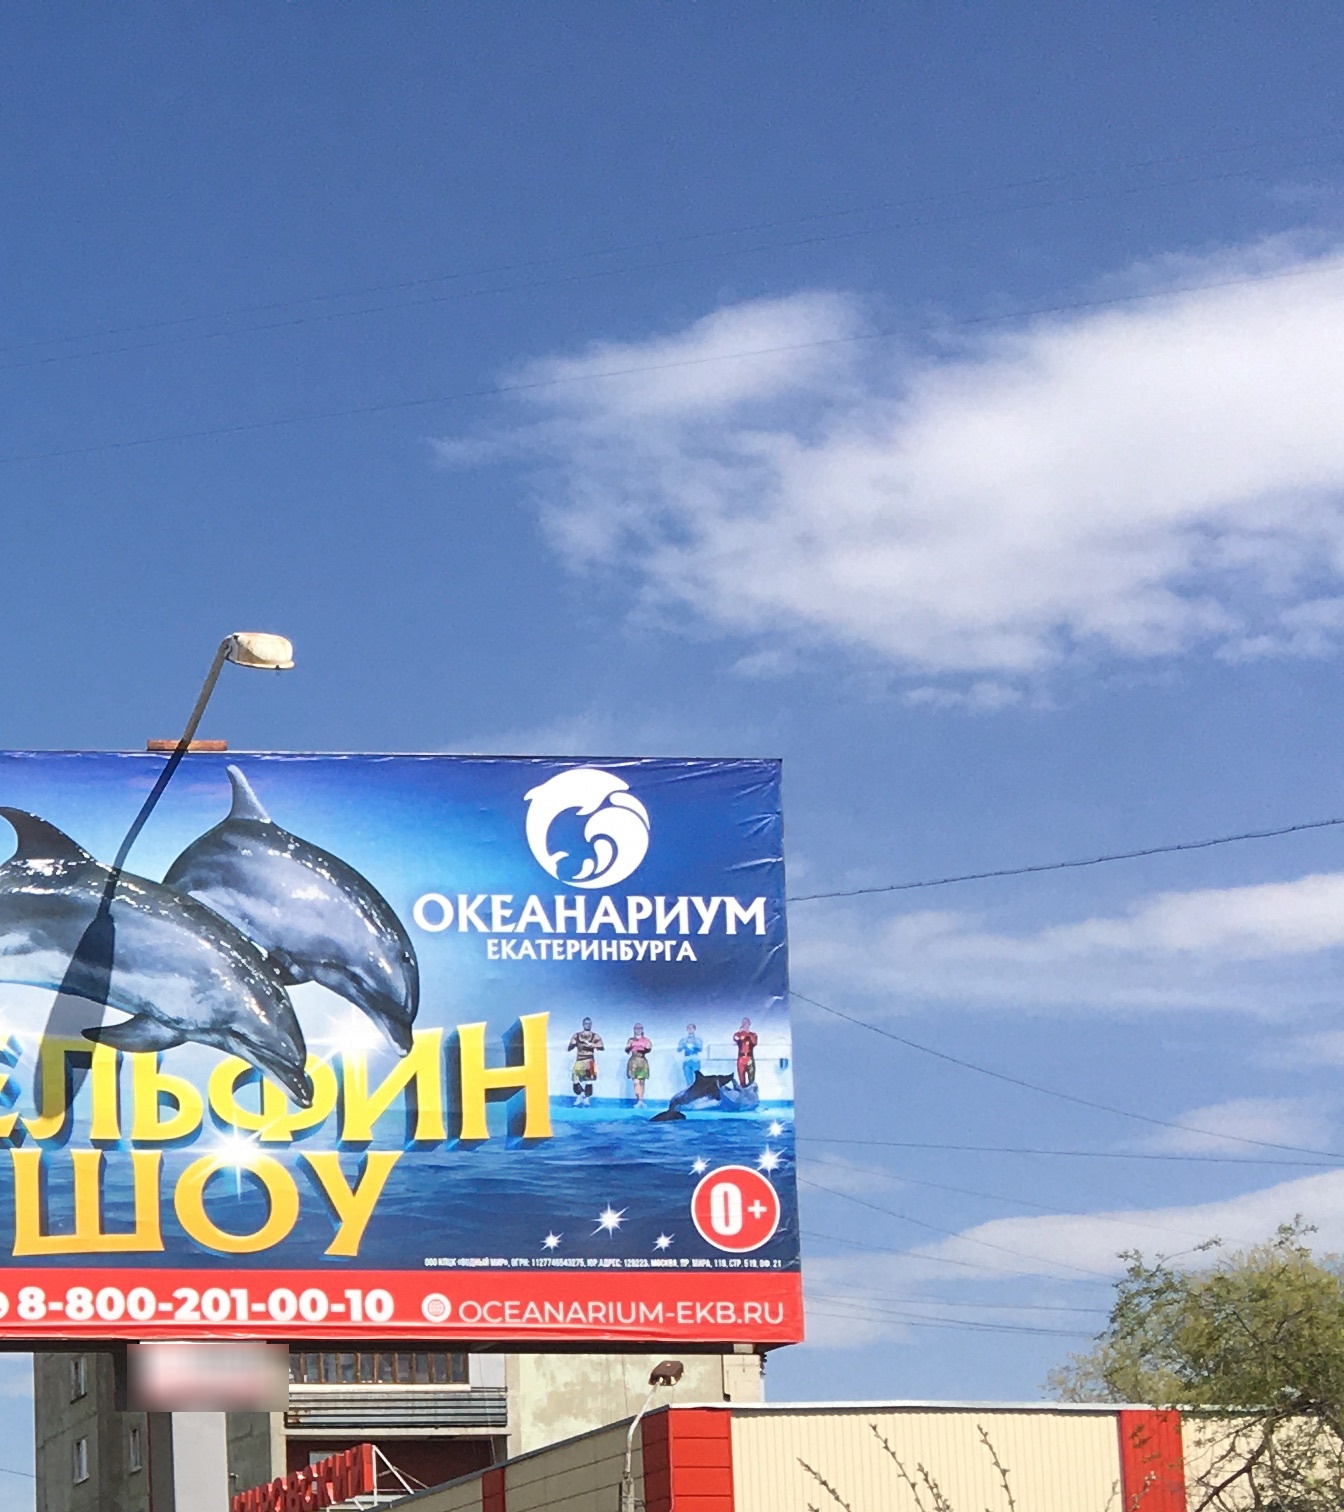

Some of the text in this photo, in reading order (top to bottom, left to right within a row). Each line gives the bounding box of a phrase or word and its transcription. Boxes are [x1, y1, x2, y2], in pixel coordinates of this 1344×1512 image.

[413, 893, 767, 936] ОКЕАНАРИУМ
[486, 938, 697, 962] ЕКАТЕРИНБУРГА
[13, 1146, 403, 1257] ШОУ
[710, 1182, 768, 1236] 0+
[17, 1286, 394, 1322] 8-800-201-00-10
[458, 1299, 784, 1325] OCEANARIUM-EKB.RU
